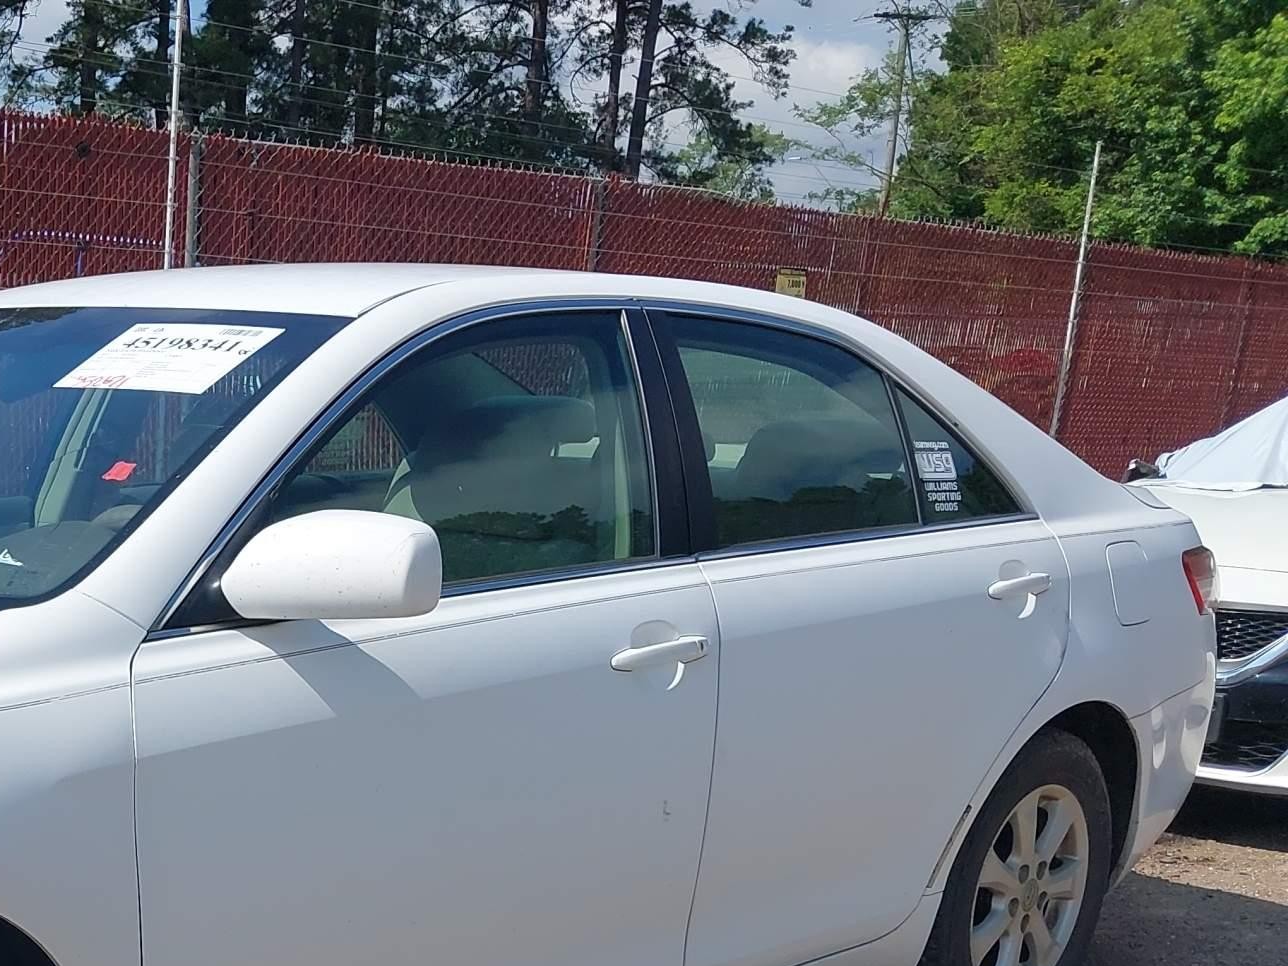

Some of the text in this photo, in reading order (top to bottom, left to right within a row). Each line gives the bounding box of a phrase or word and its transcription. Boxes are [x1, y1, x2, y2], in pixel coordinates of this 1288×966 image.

[123, 336, 243, 352] 45198341
[924, 482, 958, 491] WILLIAMS
[927, 492, 962, 501] SPORTING
[935, 503, 958, 511] GOODS
